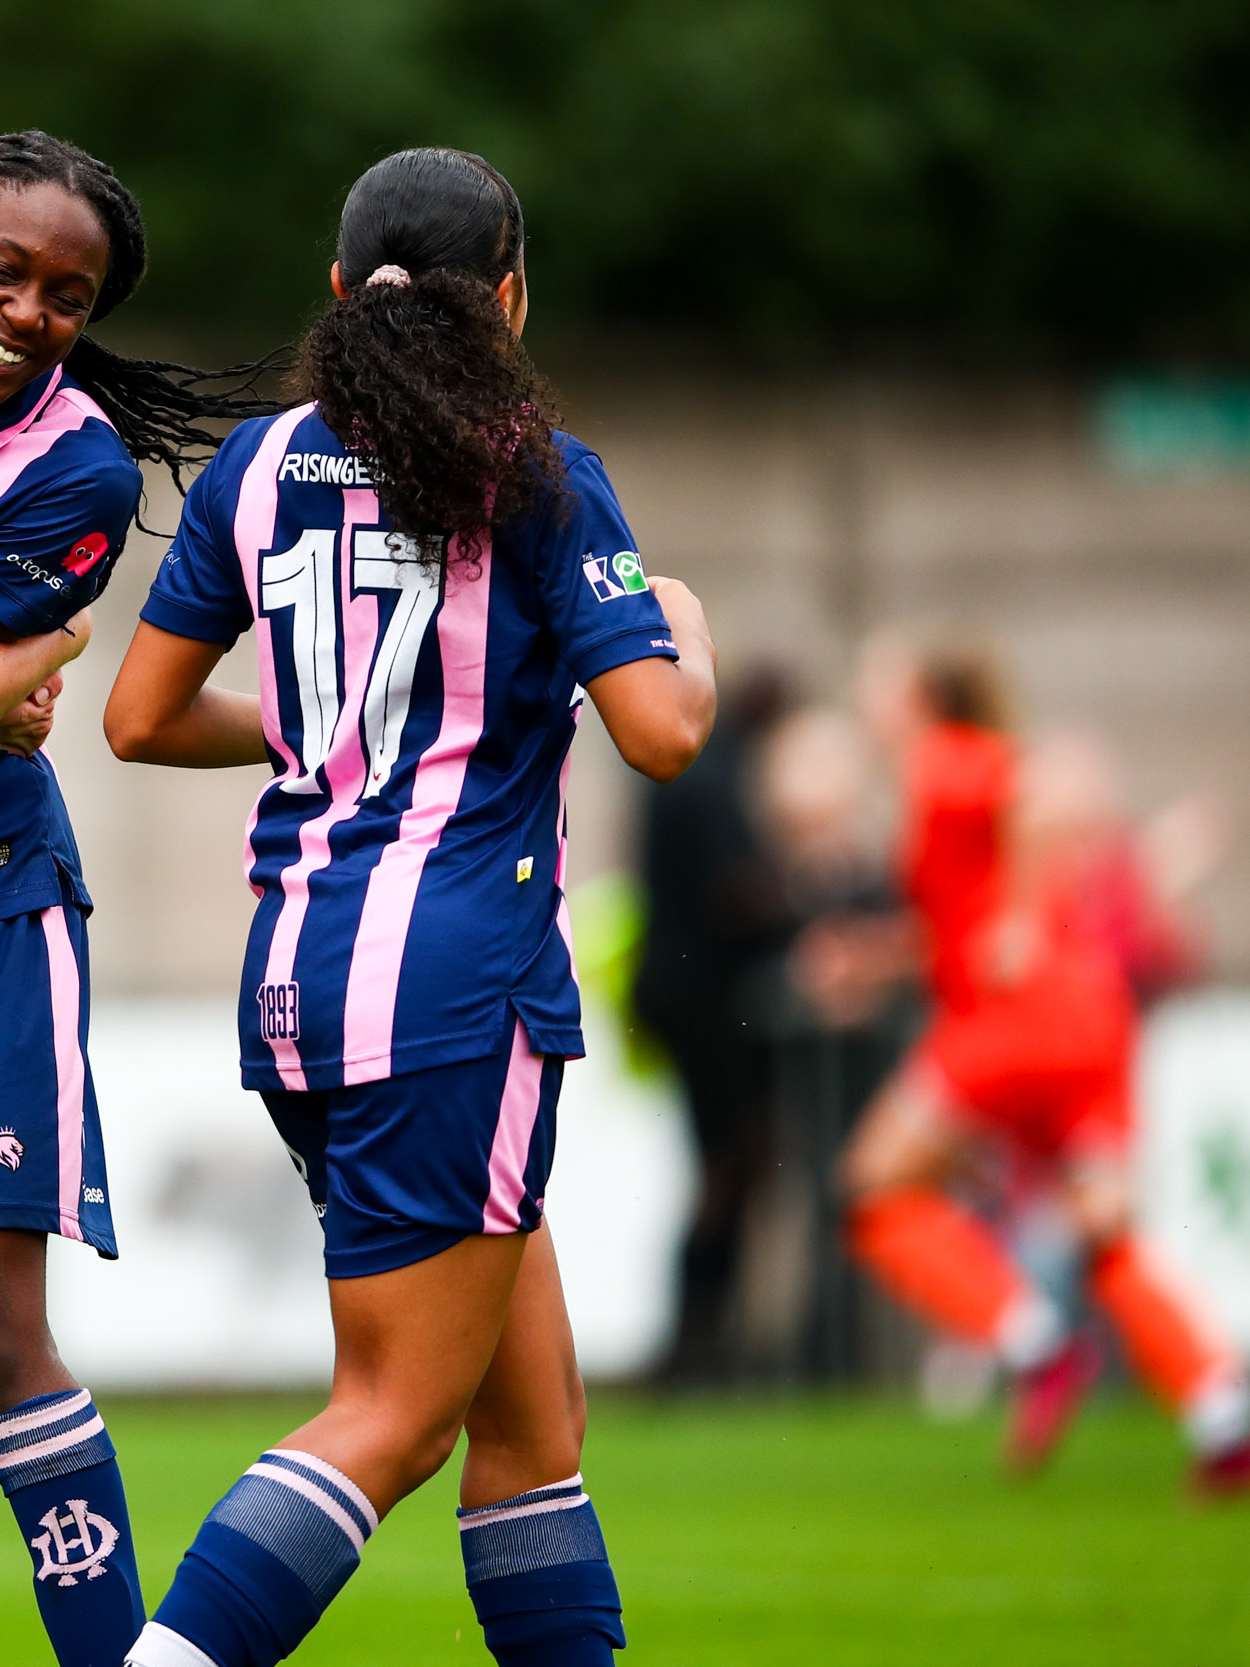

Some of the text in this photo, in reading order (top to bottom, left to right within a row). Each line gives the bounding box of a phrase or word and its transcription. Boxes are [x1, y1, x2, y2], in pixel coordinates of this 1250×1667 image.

[278, 453, 386, 485] RISINGE
[582, 552, 595, 563] THE
[262, 529, 444, 800] 17
[256, 981, 300, 1042] 1893
